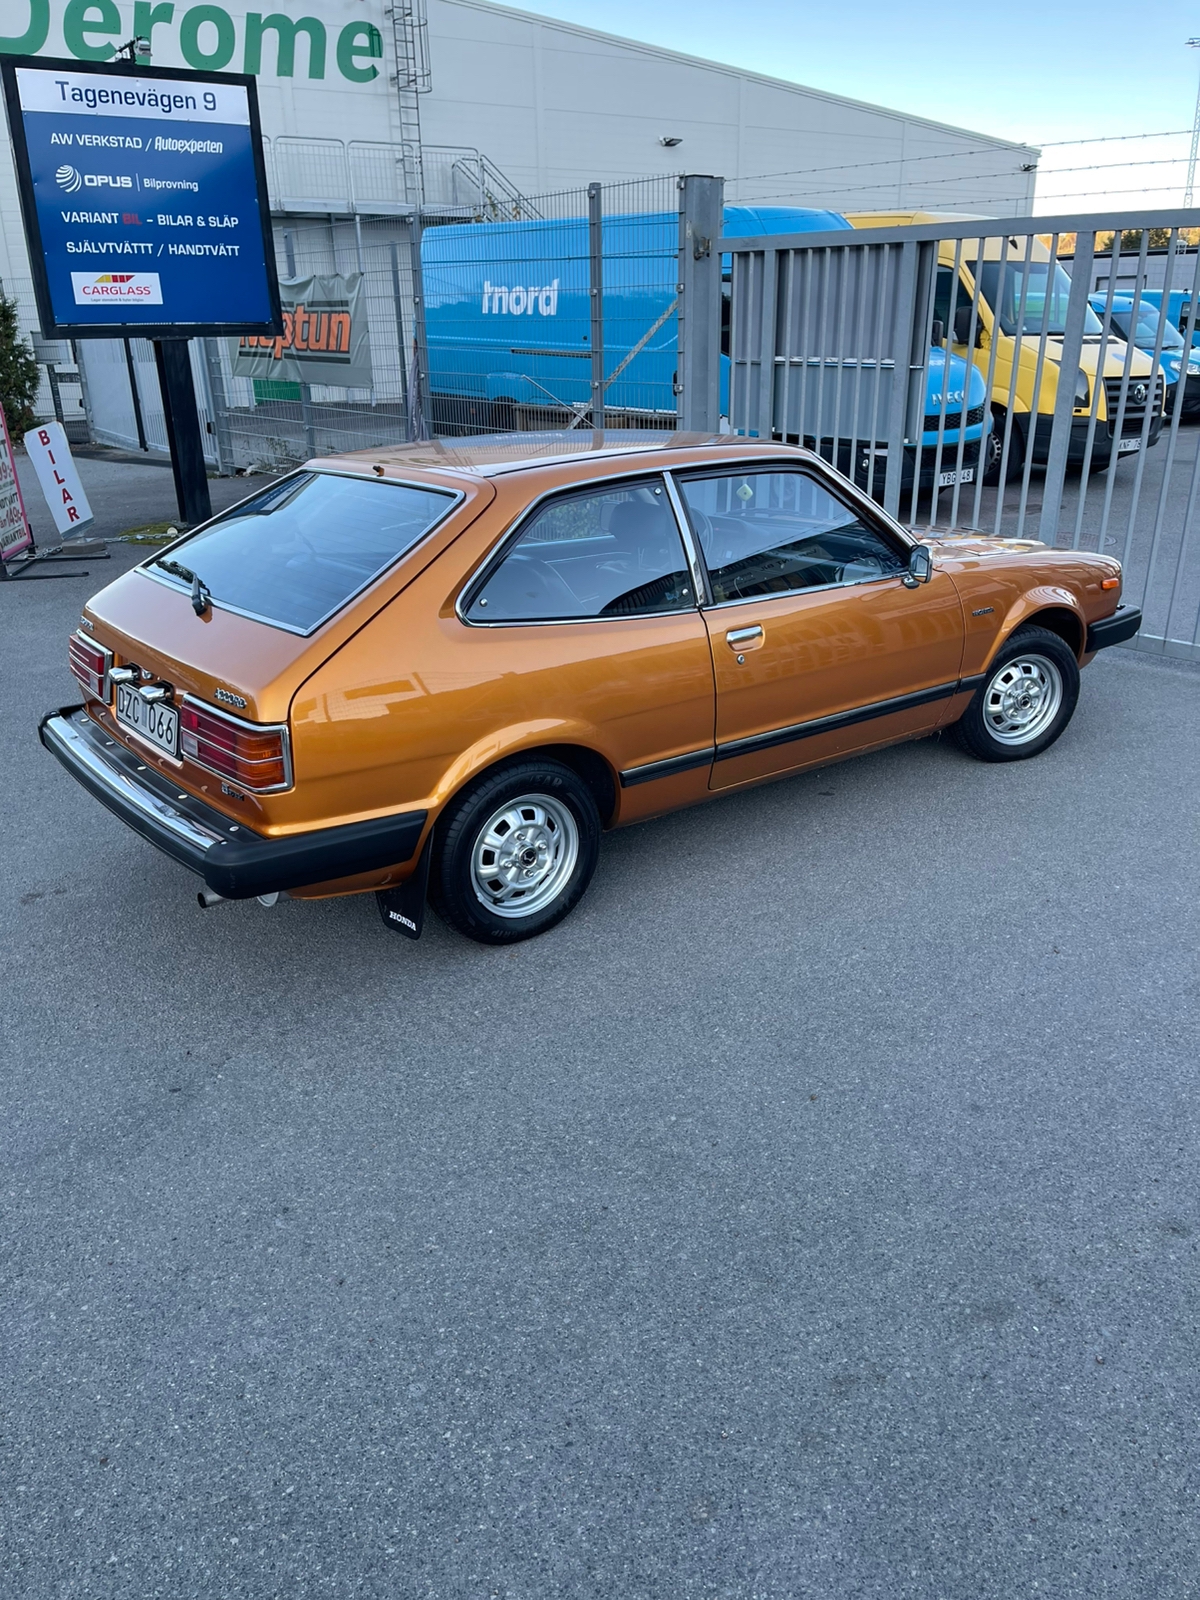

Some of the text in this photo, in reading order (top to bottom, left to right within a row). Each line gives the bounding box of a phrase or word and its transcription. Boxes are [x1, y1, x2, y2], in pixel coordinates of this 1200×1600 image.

[55, 80, 217, 113] Tagenevägen 9
[50, 133, 73, 145] AW
[75, 134, 142, 149] VERKSTAD
[154, 136, 223, 154] Autoexperten
[84, 174, 199, 192] OPUS Bilprovning
[61, 211, 119, 224] VARIANT
[122, 213, 142, 225] BIL
[157, 214, 194, 226] BILAR
[197, 216, 206, 227] &
[208, 215, 239, 228] SLÄP
[168, 243, 240, 256] HANDTVÄTT
[82, 286, 151, 295] CARGLASS
[239, 303, 351, 360] ptun
[118, 686, 174, 745] DZC 066
[389, 910, 417, 932] HONDA
